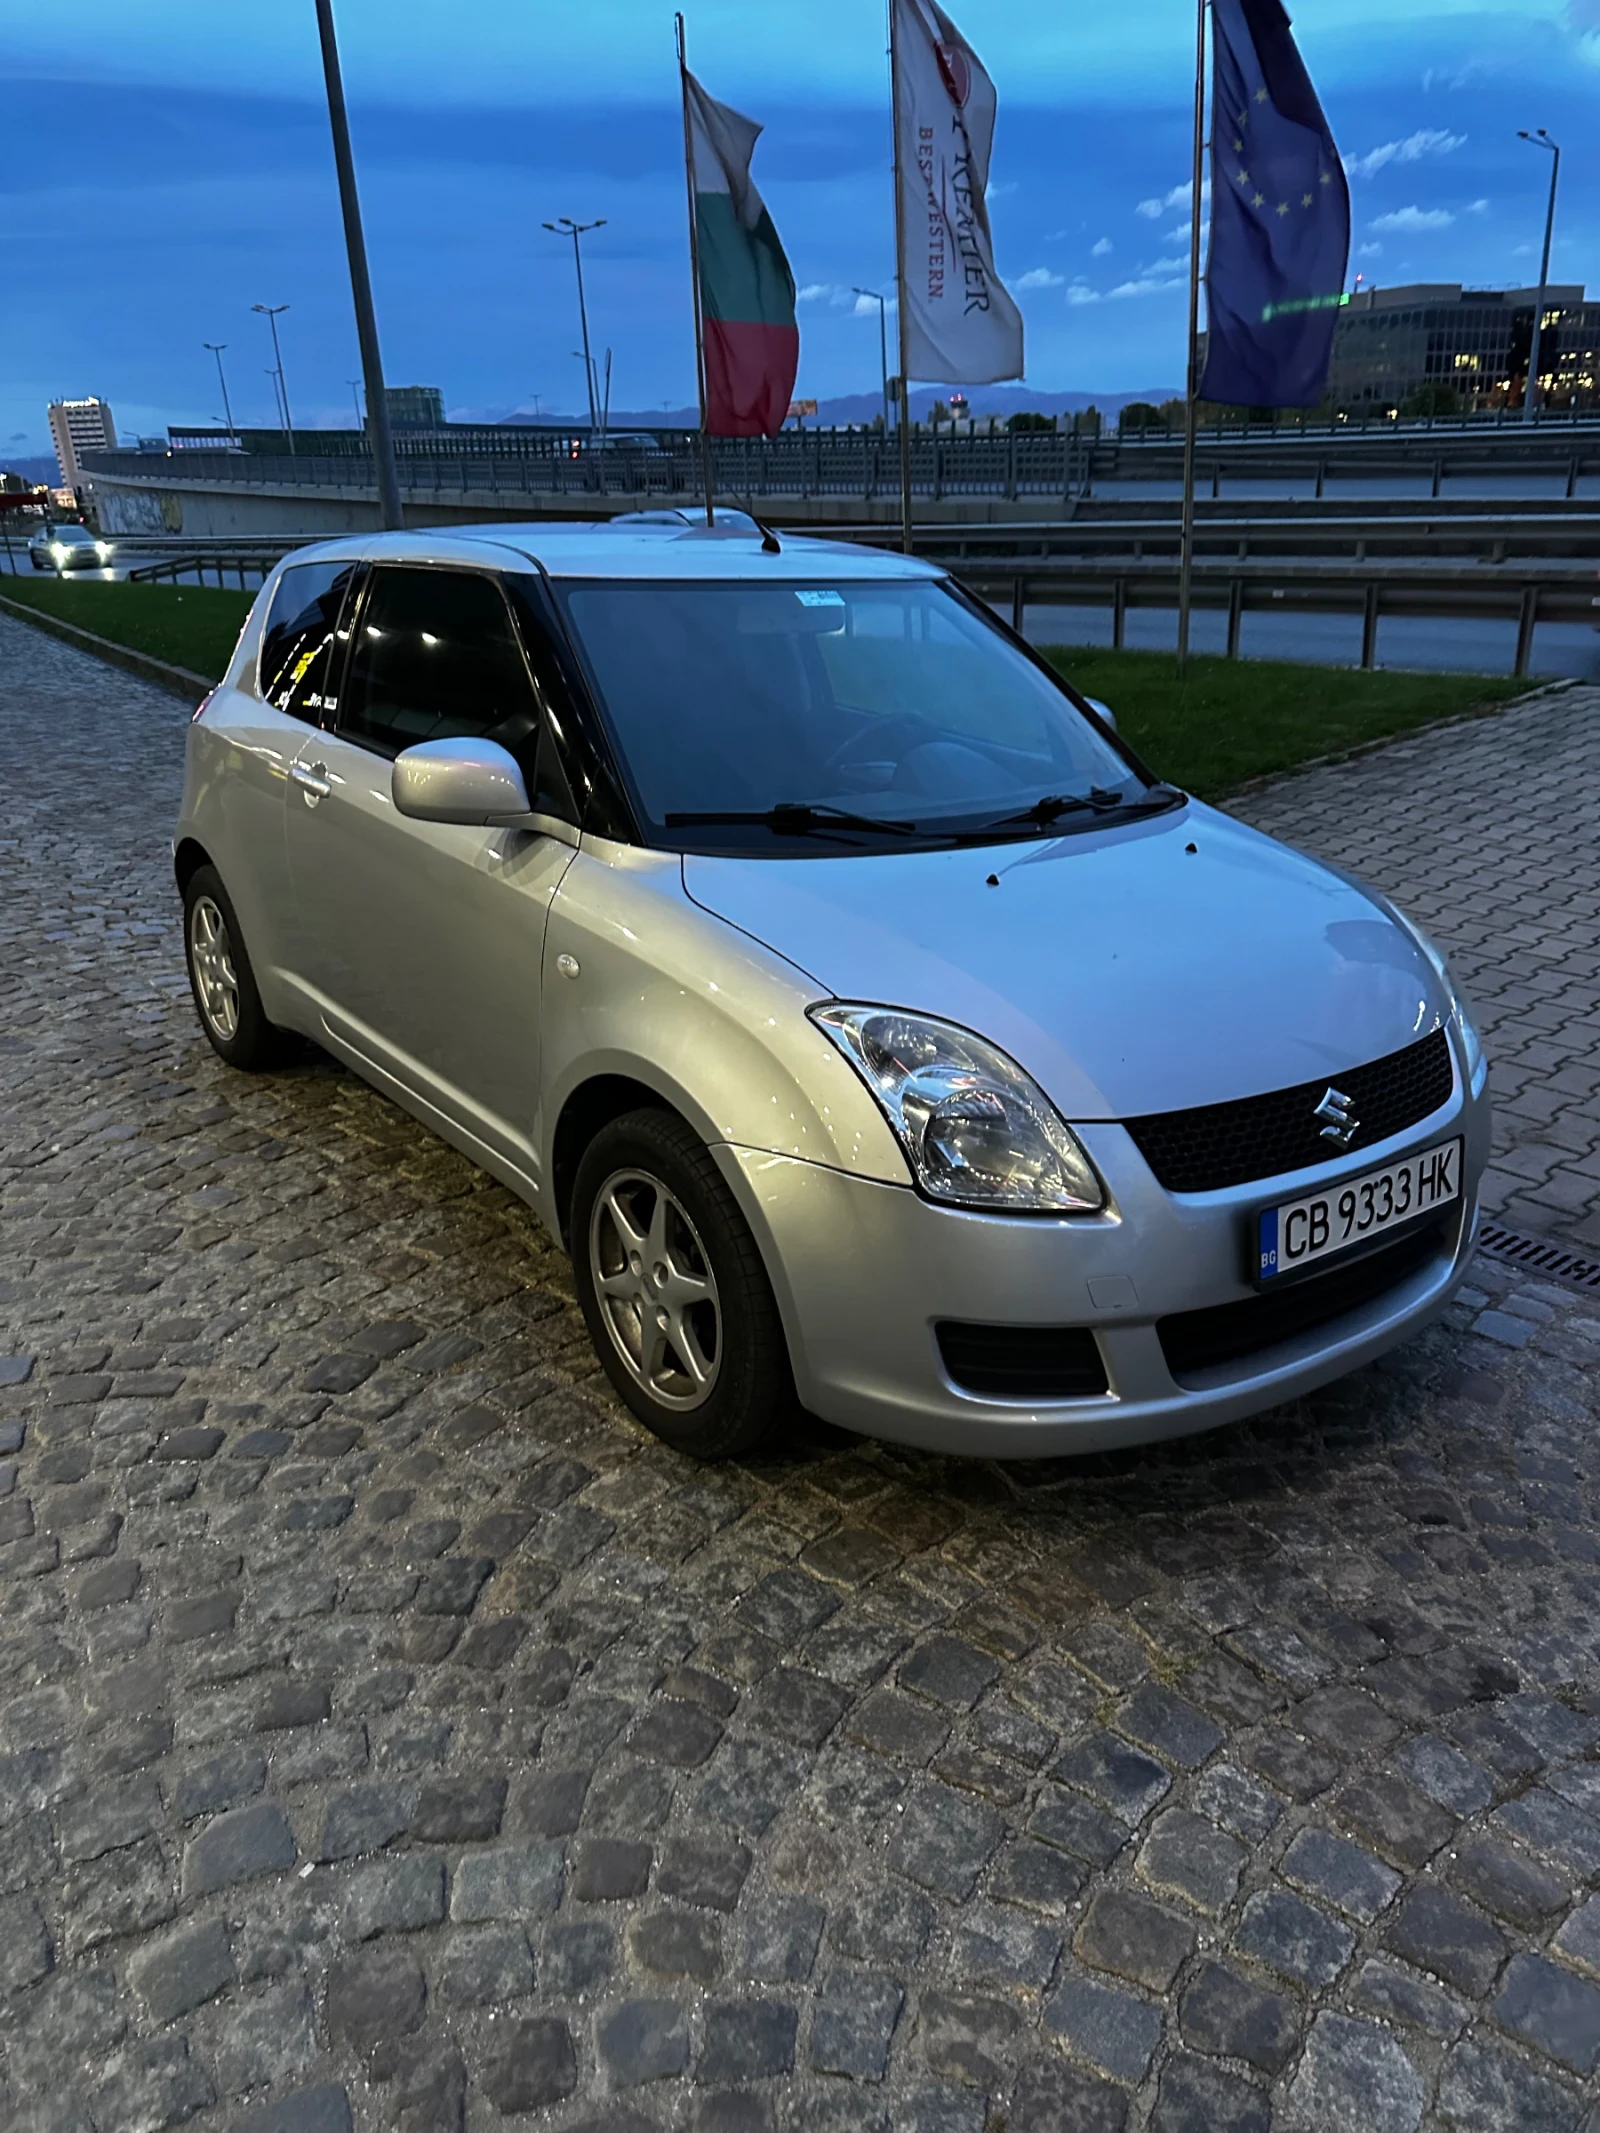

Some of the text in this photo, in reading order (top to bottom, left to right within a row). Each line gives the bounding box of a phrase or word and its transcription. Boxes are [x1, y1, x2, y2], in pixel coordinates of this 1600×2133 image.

[1285, 1148, 1454, 1259] CB 9333 HK
[1261, 1250, 1276, 1269] BG
